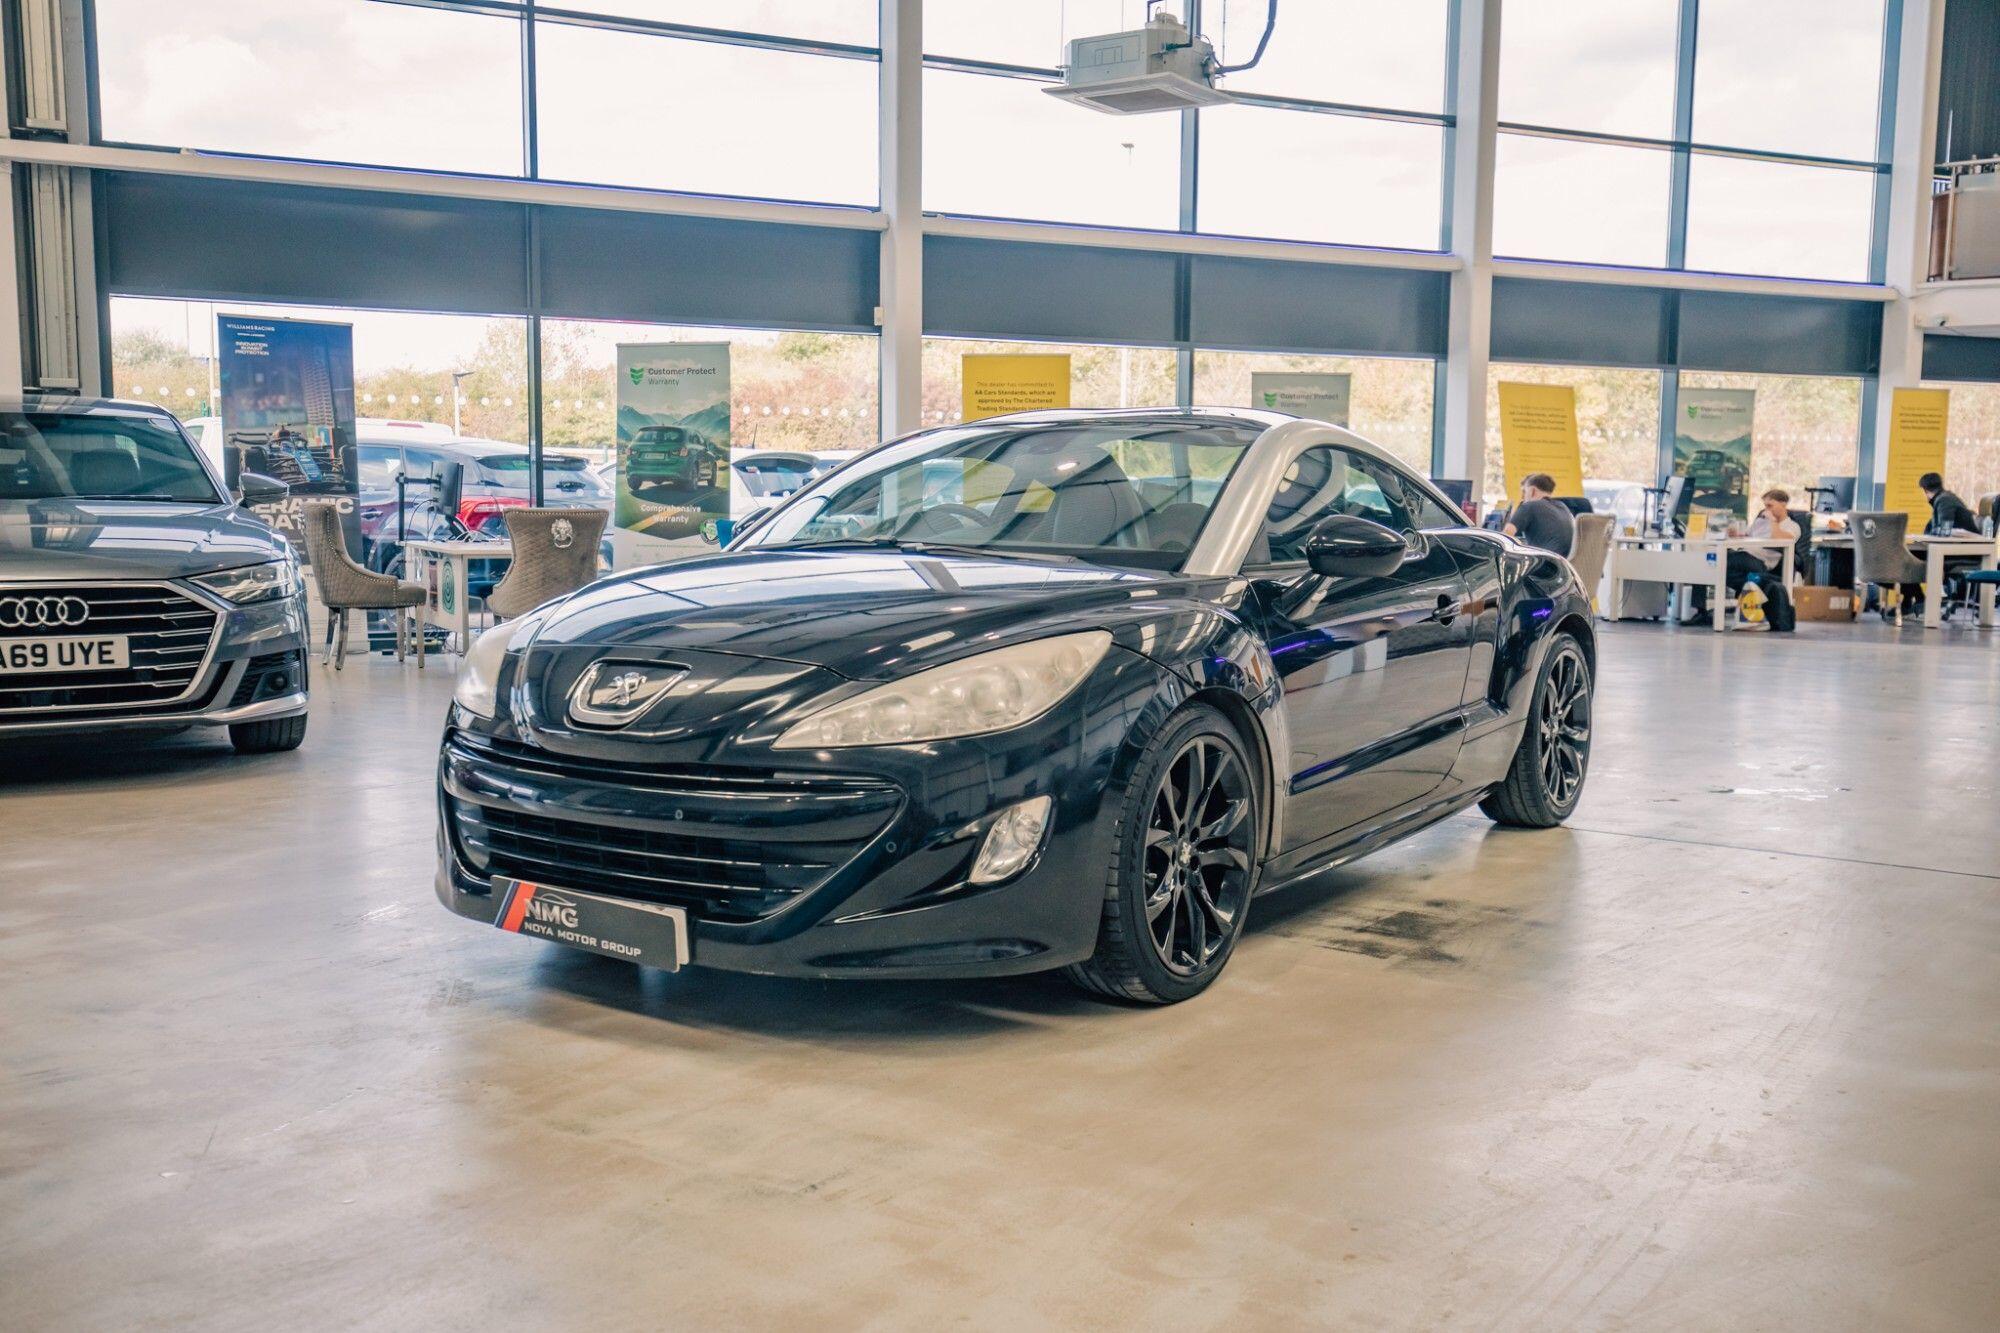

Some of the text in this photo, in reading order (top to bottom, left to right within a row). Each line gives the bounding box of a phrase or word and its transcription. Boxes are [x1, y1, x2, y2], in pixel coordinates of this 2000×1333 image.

[687, 367, 716, 375] Protect
[250, 498, 354, 514] ERAC
[640, 504, 701, 513] Comprehensive
[57, 641, 115, 666] UYE
[524, 898, 579, 928] NMG
[524, 921, 642, 957] NOYA MOTOR GROUP
